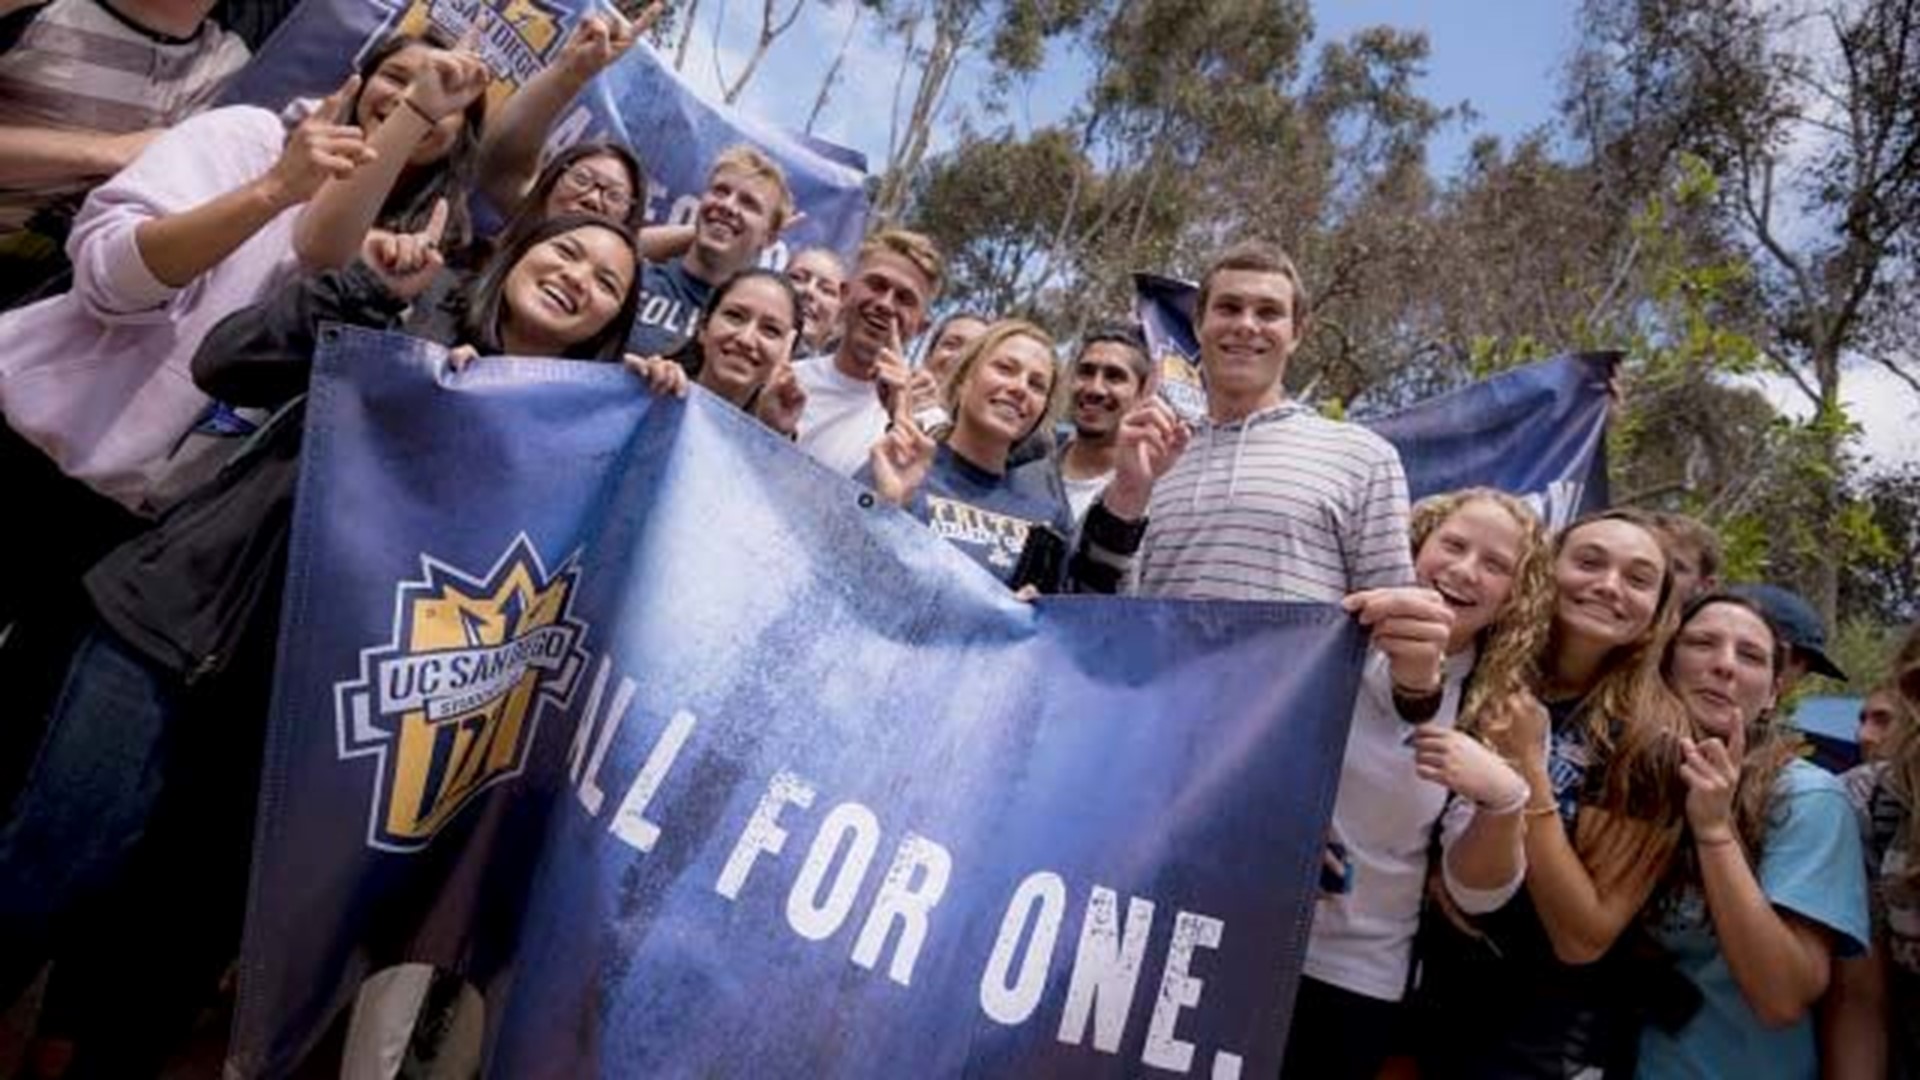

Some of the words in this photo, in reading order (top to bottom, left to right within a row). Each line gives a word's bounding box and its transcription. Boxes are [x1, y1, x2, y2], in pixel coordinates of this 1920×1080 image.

[389, 659, 440, 701] UC
[449, 651, 509, 691] SAN
[715, 764, 953, 987] FOR
[980, 870, 1243, 1080] ONE.
